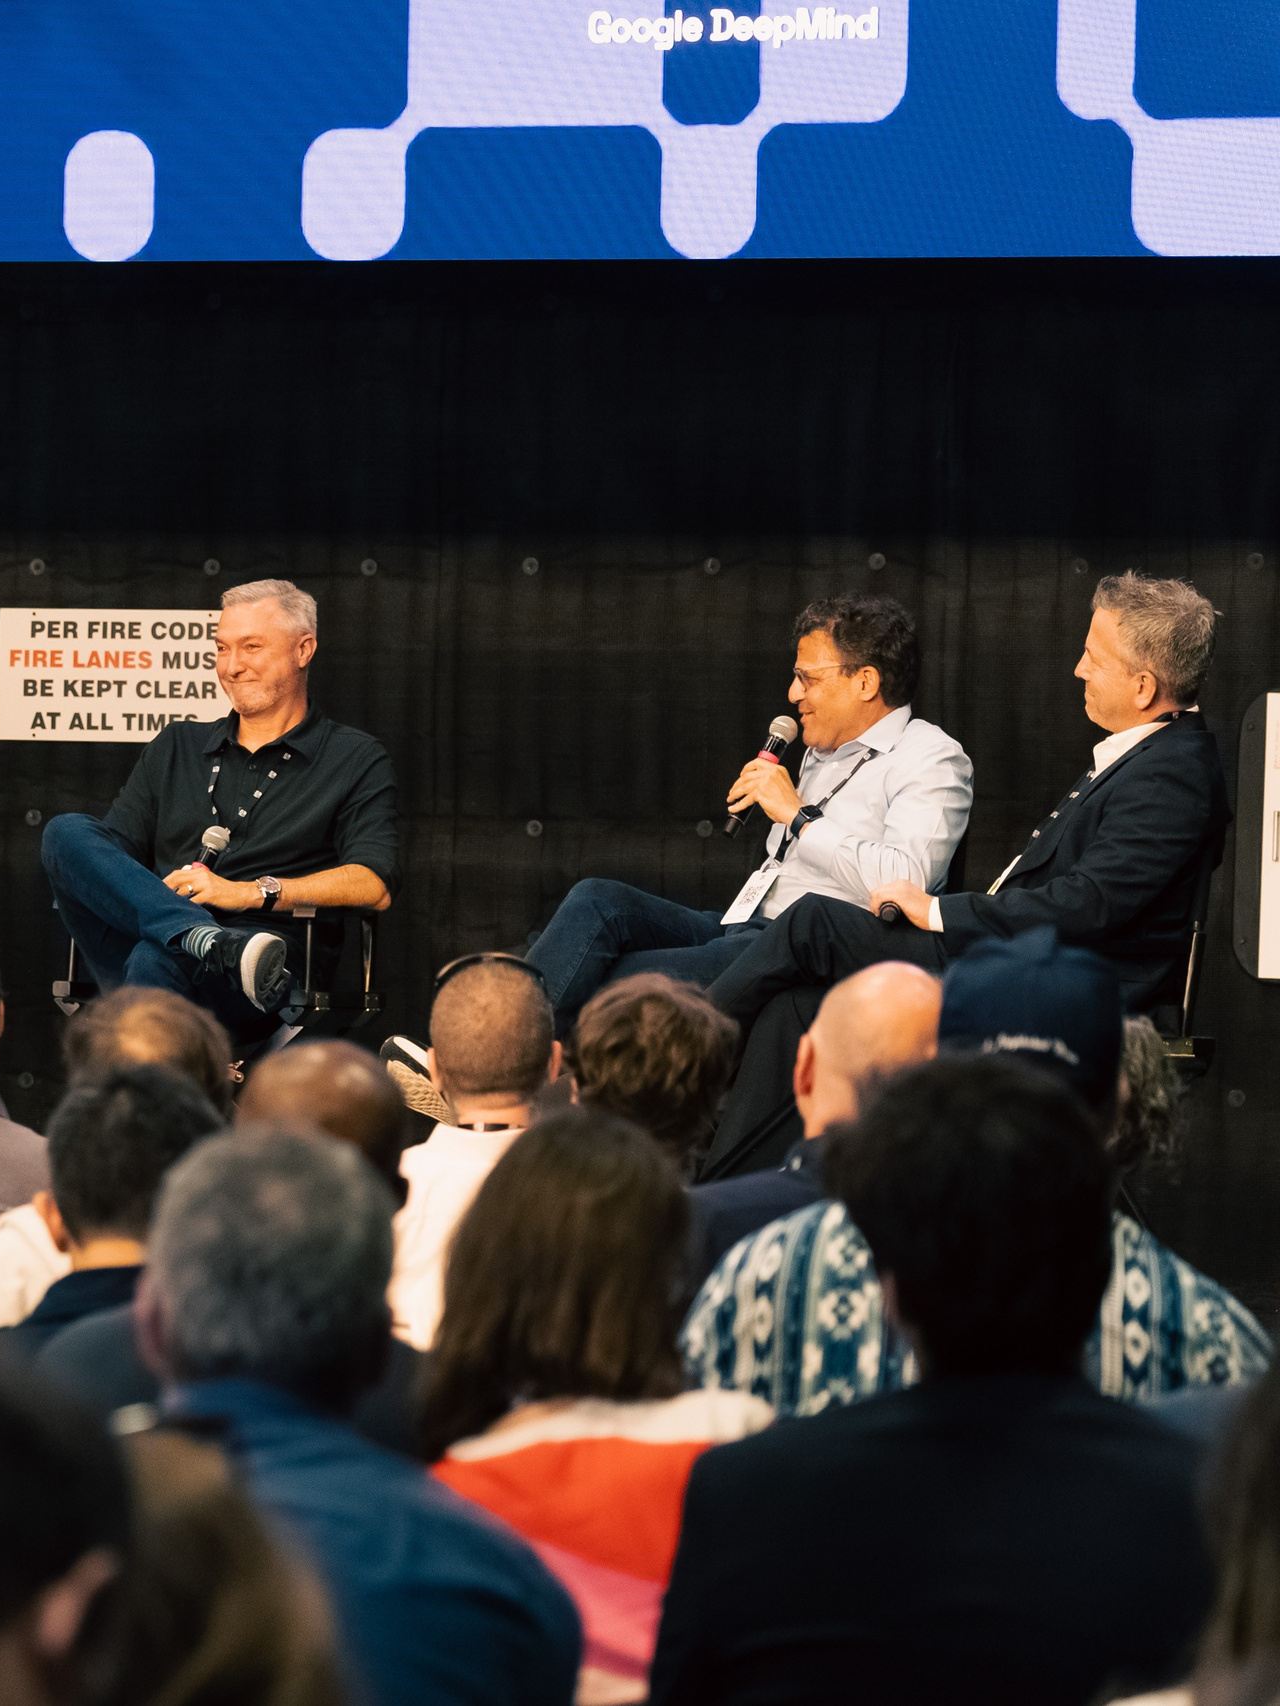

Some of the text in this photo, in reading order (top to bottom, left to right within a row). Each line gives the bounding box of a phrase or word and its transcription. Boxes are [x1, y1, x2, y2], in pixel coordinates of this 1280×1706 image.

[587, 6, 879, 51] Google DeepMind
[30, 620, 218, 640] PER FIRE CODE
[9, 649, 217, 670] FIRE LANES MUS
[23, 679, 217, 699] BE KEPT CLEAR
[30, 711, 61, 730] AT
[69, 712, 114, 731] ALL
